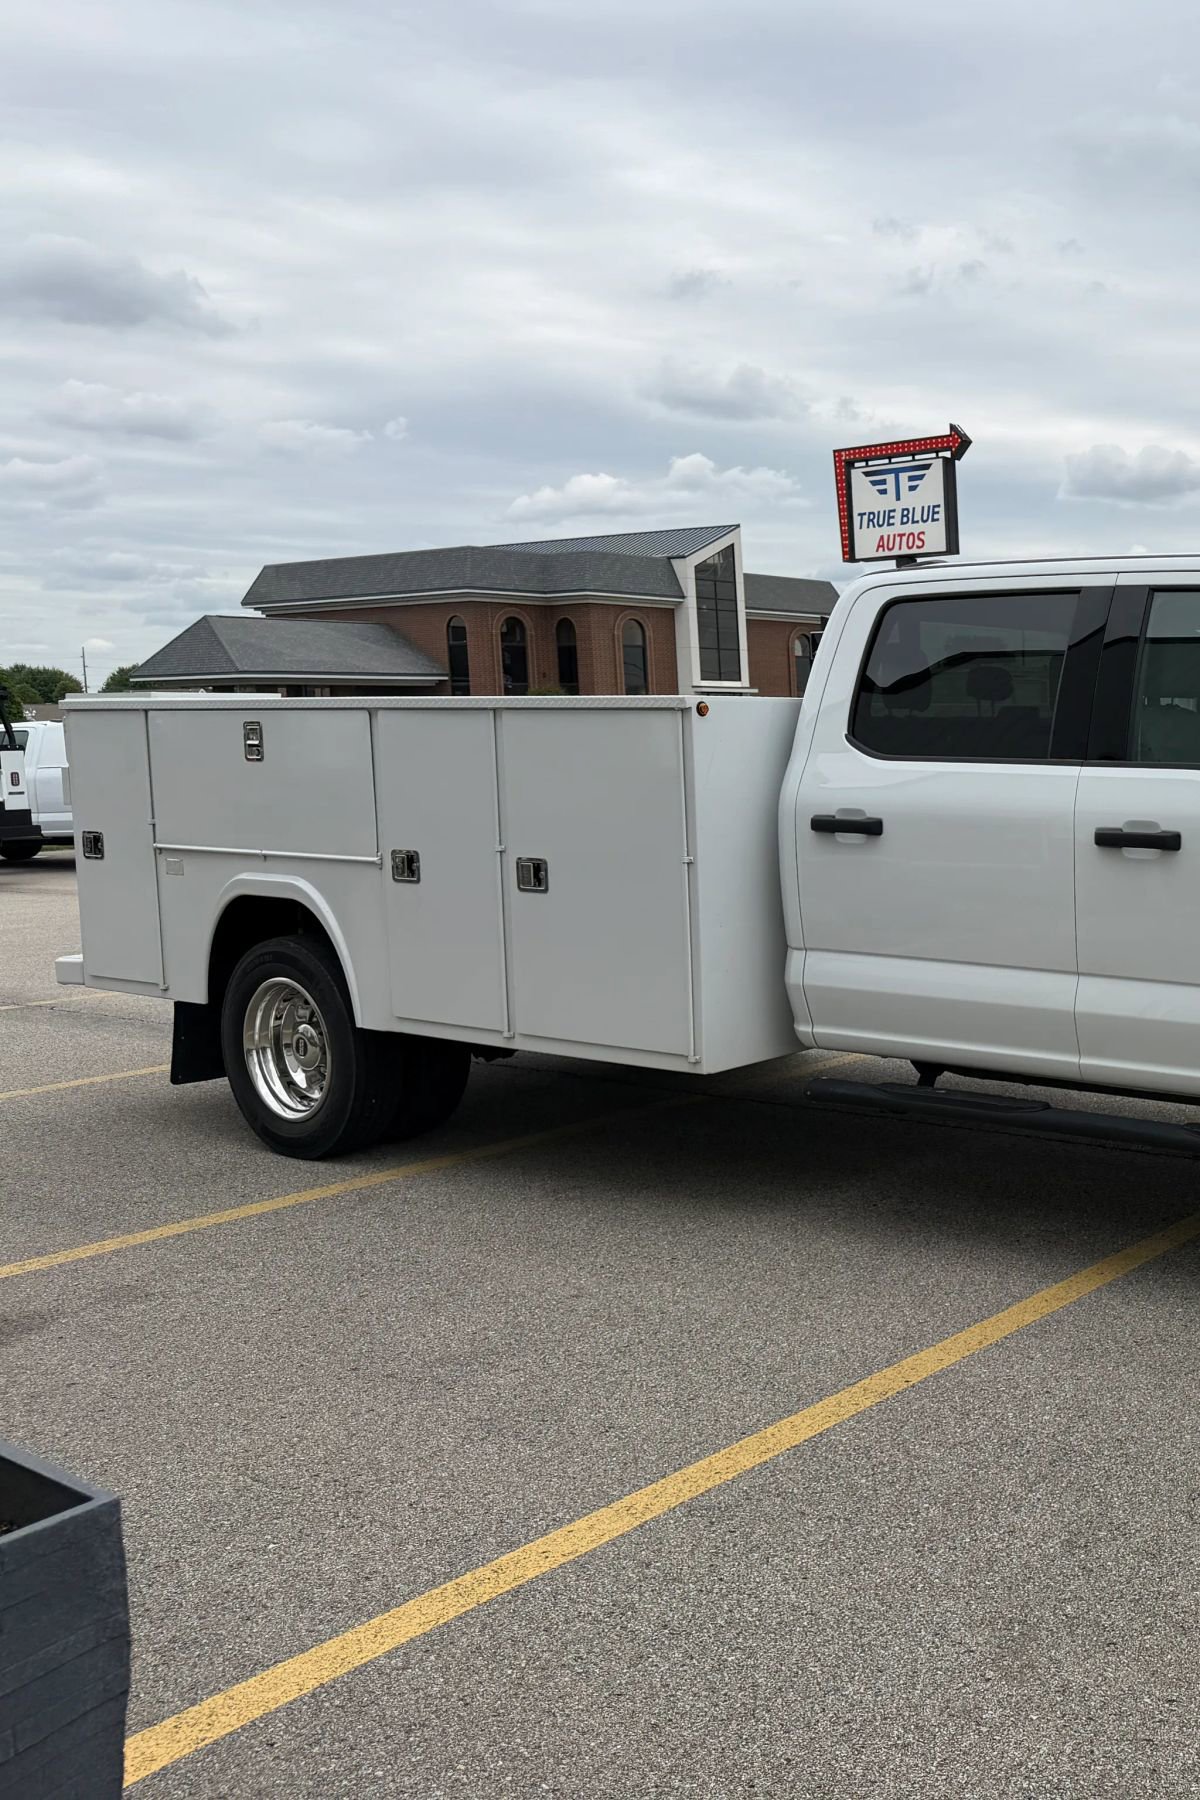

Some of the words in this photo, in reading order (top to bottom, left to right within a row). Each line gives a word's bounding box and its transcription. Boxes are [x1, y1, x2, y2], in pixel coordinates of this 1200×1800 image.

[857, 508, 896, 530] TRUE
[900, 504, 941, 526] BLUE
[875, 531, 926, 552] AUTOS
